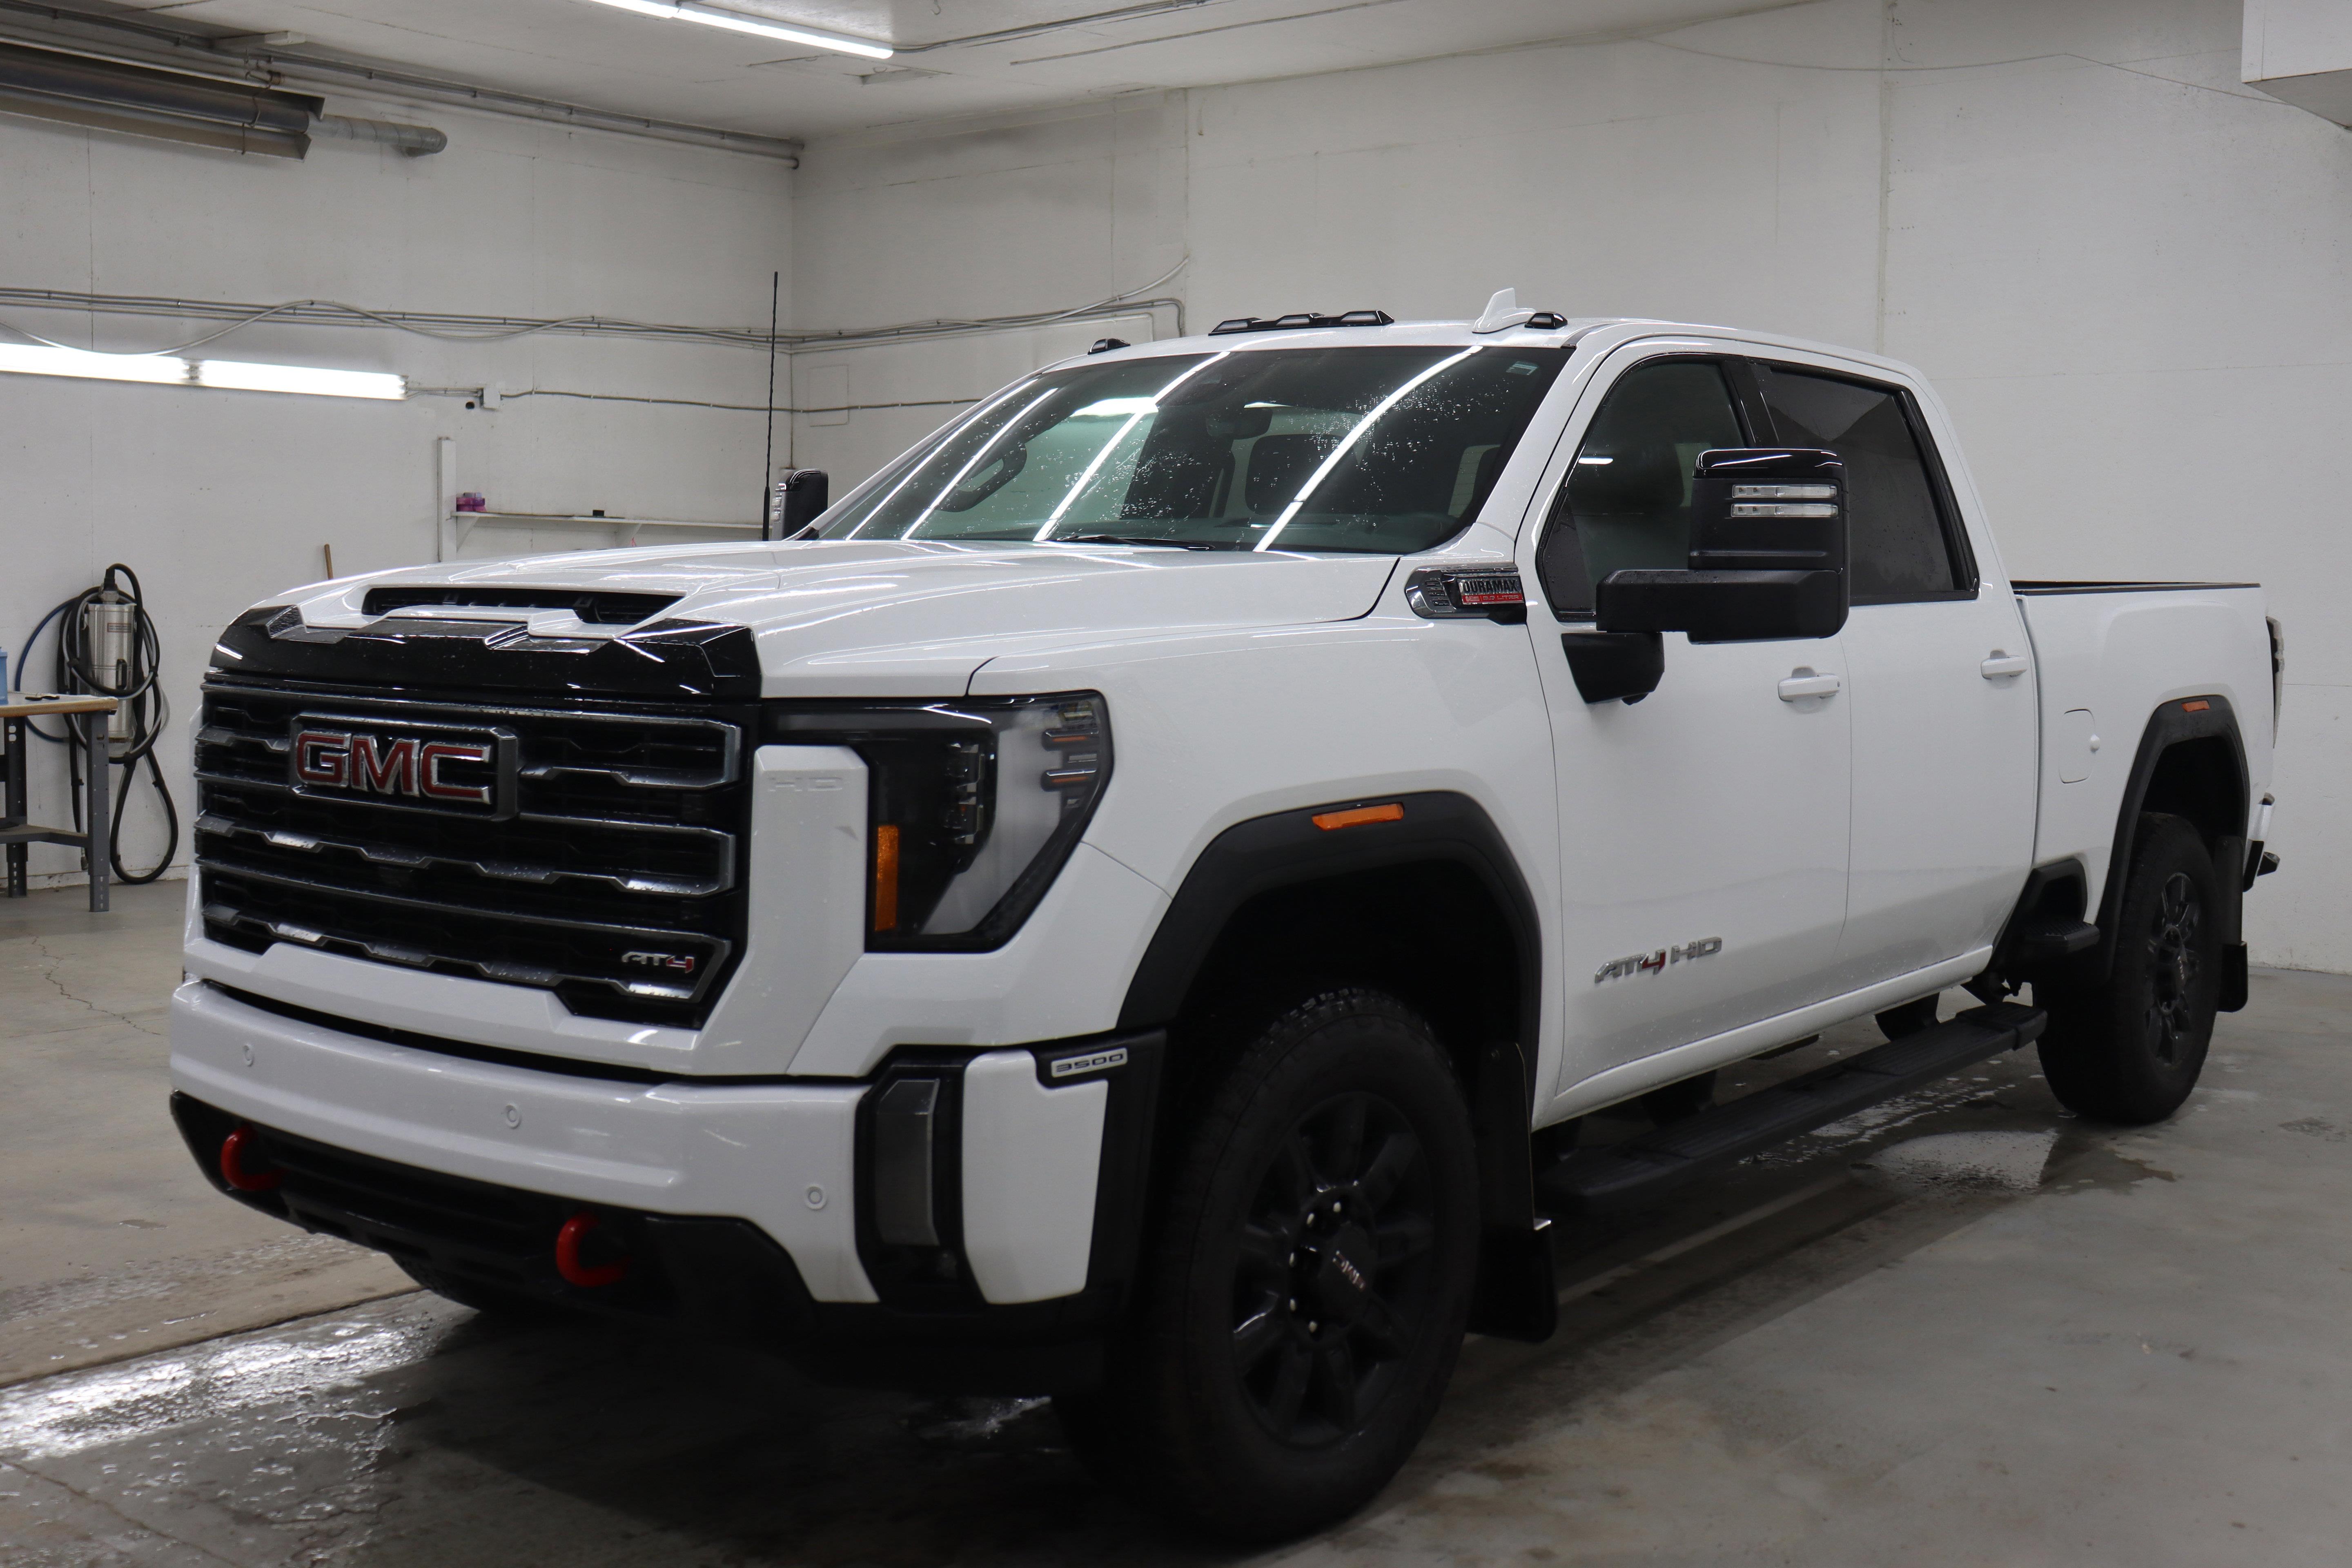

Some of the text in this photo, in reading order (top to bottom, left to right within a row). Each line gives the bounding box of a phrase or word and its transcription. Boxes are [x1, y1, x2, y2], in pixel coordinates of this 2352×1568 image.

[1461, 580, 1518, 592] DURAMAX
[297, 728, 491, 804] GMC
[621, 952, 695, 973] AT4
[1595, 937, 1722, 983] AT4 HD
[1056, 1054, 1123, 1072] 3500
